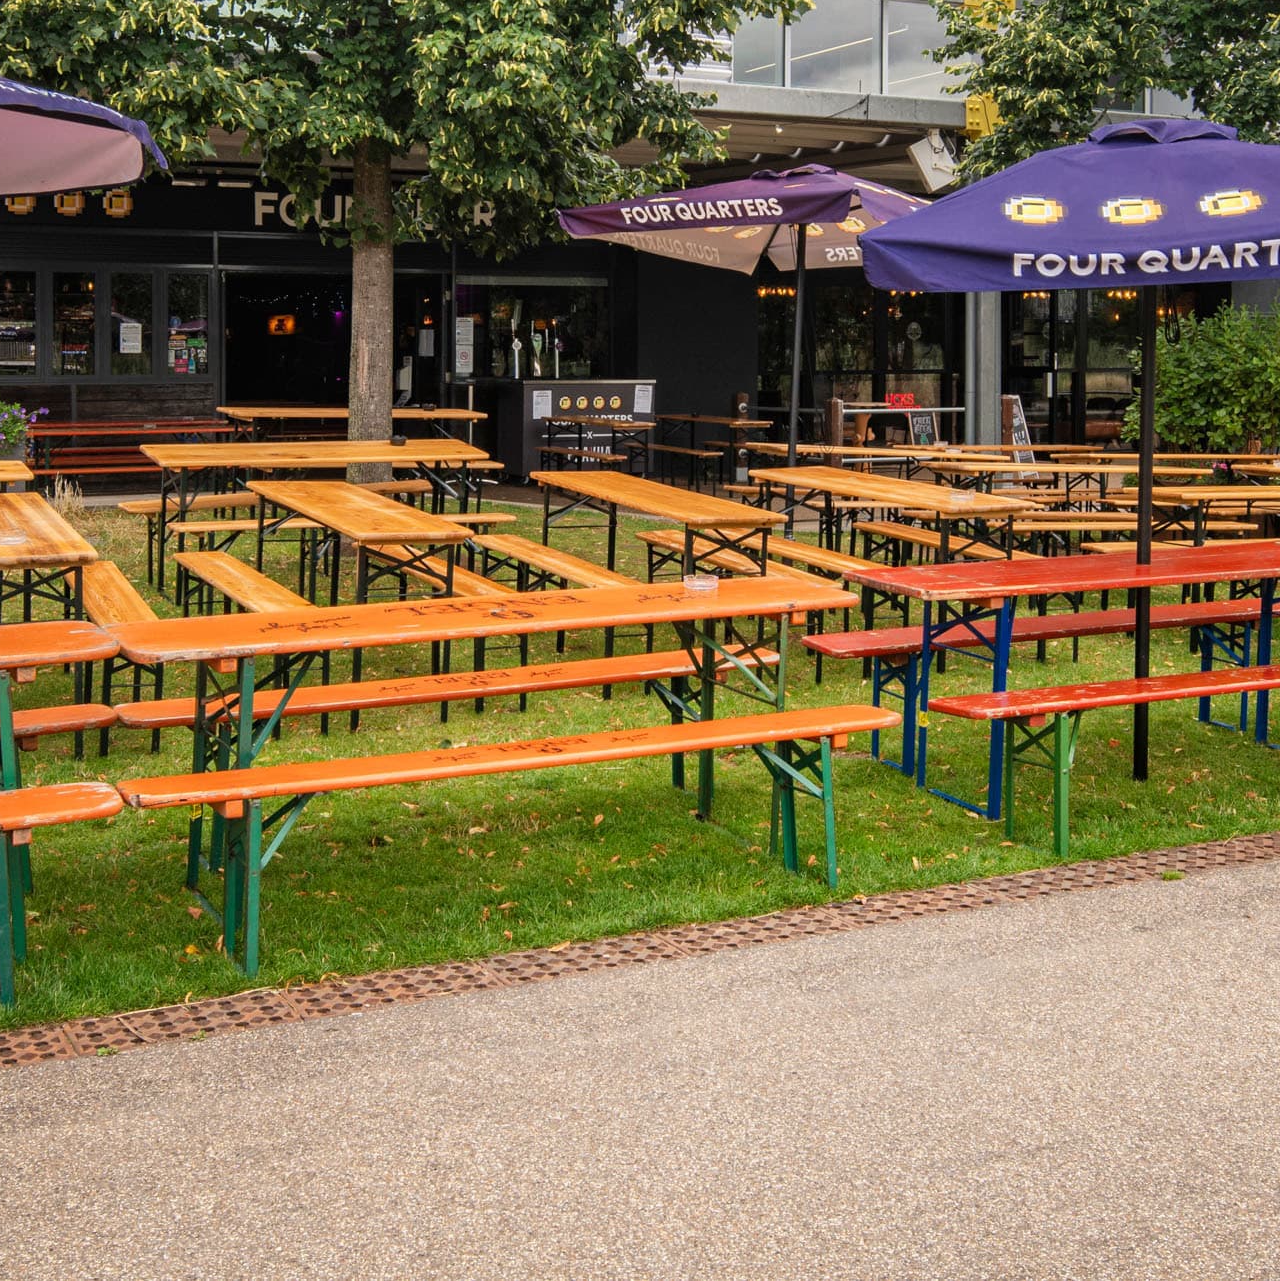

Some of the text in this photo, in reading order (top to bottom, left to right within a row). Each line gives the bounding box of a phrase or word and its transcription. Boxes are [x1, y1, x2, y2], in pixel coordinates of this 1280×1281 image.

[621, 197, 783, 224] FOUR QUARTERS
[1013, 252, 1125, 277] FOUR
